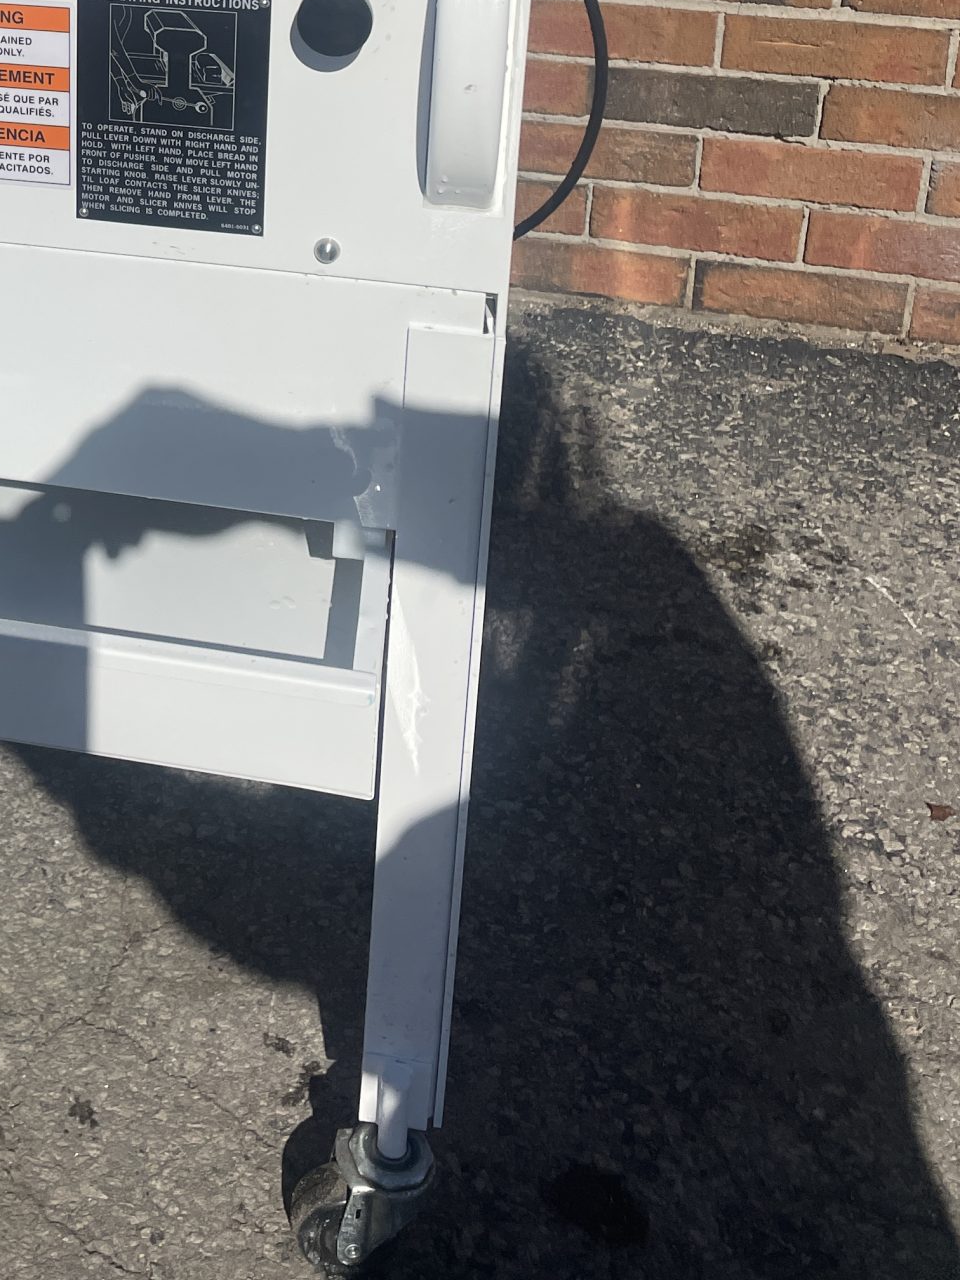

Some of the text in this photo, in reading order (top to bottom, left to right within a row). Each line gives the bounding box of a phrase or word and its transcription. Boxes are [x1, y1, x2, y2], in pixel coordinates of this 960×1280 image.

[13, 94, 34, 104] QUE
[38, 96, 59, 106] PAR
[140, 128, 167, 136] STAND
[187, 131, 235, 141] DISCHARGE
[81, 132, 101, 140] PULL
[103, 134, 129, 142] LEVER
[132, 136, 157, 144] DOWN
[184, 141, 210, 149] RIGHT
[213, 143, 237, 151] HAND
[240, 145, 258, 153] AND
[28, 153, 50, 163] POR
[81, 150, 107, 158] FRONT
[185, 158, 209, 166] MOVE
[234, 162, 258, 170] HAND
[187, 150, 214, 158] PLACE
[217, 152, 245, 161] BREAD
[81, 167, 120, 176] STARTING
[154, 173, 177, 181] RAISE
[181, 176, 207, 184] LEVER
[209, 178, 241, 187] SLOWLY
[98, 160, 144, 170] DISCHARGE
[150, 164, 169, 172] SIDE
[175, 166, 193, 174] AND
[199, 168, 220, 176] PULL
[226, 171, 257, 179] MOTOR
[98, 177, 119, 185] LOAF
[124, 180, 167, 189] CONTACTS
[192, 186, 221, 194] SLICER
[108, 187, 142, 196] REMOVE
[147, 190, 171, 198] HAND
[176, 193, 200, 201] FROM
[80, 202, 104, 210] WHEN
[109, 205, 140, 213] SLICING
[81, 193, 109, 202] MOTOR
[139, 199, 167, 207] SLICER
[173, 202, 202, 210] KNIVES
[233, 207, 256, 215] STOP
